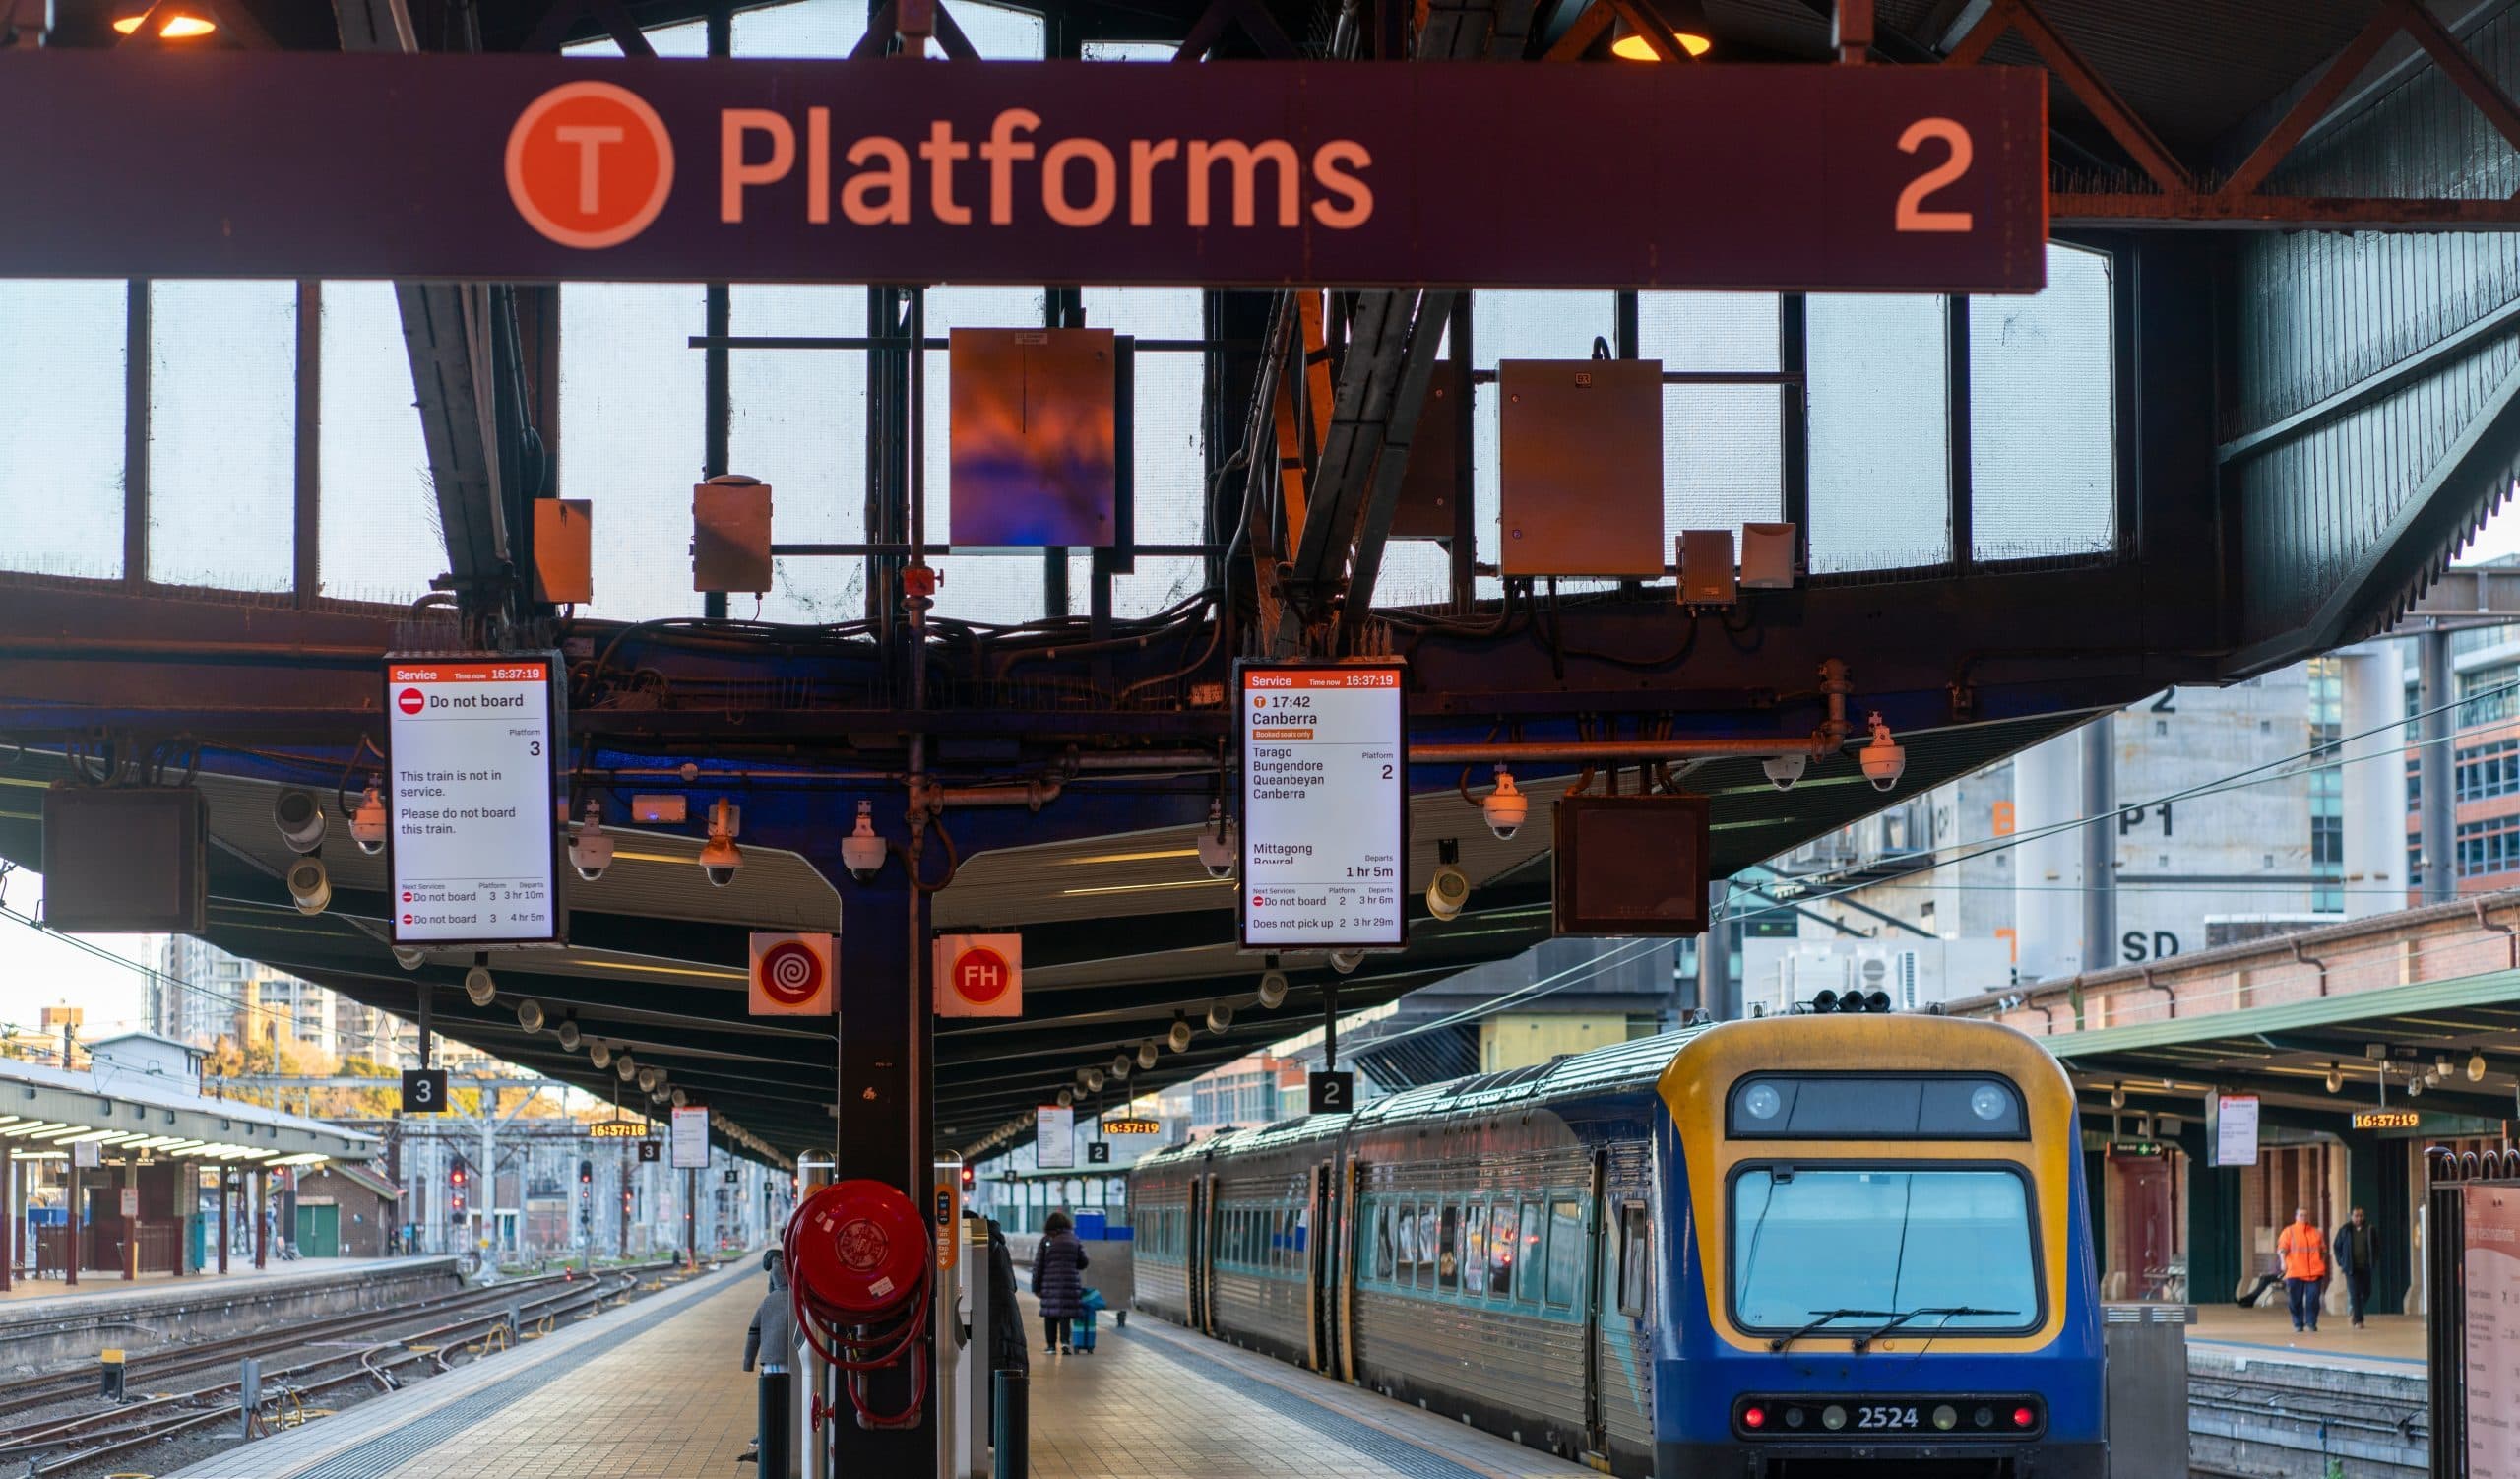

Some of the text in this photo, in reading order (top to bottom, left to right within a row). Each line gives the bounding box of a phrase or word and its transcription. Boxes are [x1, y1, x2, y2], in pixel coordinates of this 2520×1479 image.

[556, 106, 1973, 231] T Platforms 2
[397, 670, 437, 680] Service
[492, 668, 540, 679] 16:37:19
[1252, 675, 1292, 686] Service
[1346, 675, 1393, 686] 16:37:19
[430, 693, 524, 708] Do not board
[1272, 696, 1310, 708] 17:42
[1252, 712, 1317, 725] Canberra
[530, 740, 540, 756] 3
[1253, 747, 1292, 759] Tarago
[1253, 760, 1323, 773] Bungendore
[1382, 764, 1393, 779] 2
[400, 770, 502, 781] This train is not in
[1253, 774, 1324, 786] Queanbeyan
[400, 787, 445, 797] service.
[1253, 788, 1306, 800] Canberra
[401, 806, 516, 819] Please do not board
[2118, 803, 2173, 836] P1
[401, 824, 456, 834] this train.
[1253, 843, 1313, 856] Mittagong
[1364, 854, 1393, 863] Departs
[1346, 867, 1393, 877] 1 hr 5m
[413, 890, 544, 902] Do not board 3 3 hr 10m
[1265, 896, 1277, 906] Do
[1280, 897, 1295, 906] not
[1297, 896, 1326, 906] board
[1339, 896, 1346, 905] 2
[1367, 895, 1377, 904] hr
[1379, 895, 1393, 904] 6m
[414, 913, 544, 924] Do not board 3 4 hr 5m
[1253, 917, 1393, 930] Does not pick up 2 3 hr 29m
[2122, 931, 2179, 962] SD
[964, 965, 998, 986] FH
[416, 1079, 431, 1102] 3
[1324, 1081, 1339, 1104] 2
[2355, 1114, 2418, 1128] 16:37:19
[590, 1125, 646, 1136] 16:37:18
[1103, 1123, 1159, 1133] 16:37:19
[645, 1145, 654, 1158] 3
[1094, 1147, 1103, 1159] 2
[1858, 1407, 1919, 1428] 2524
